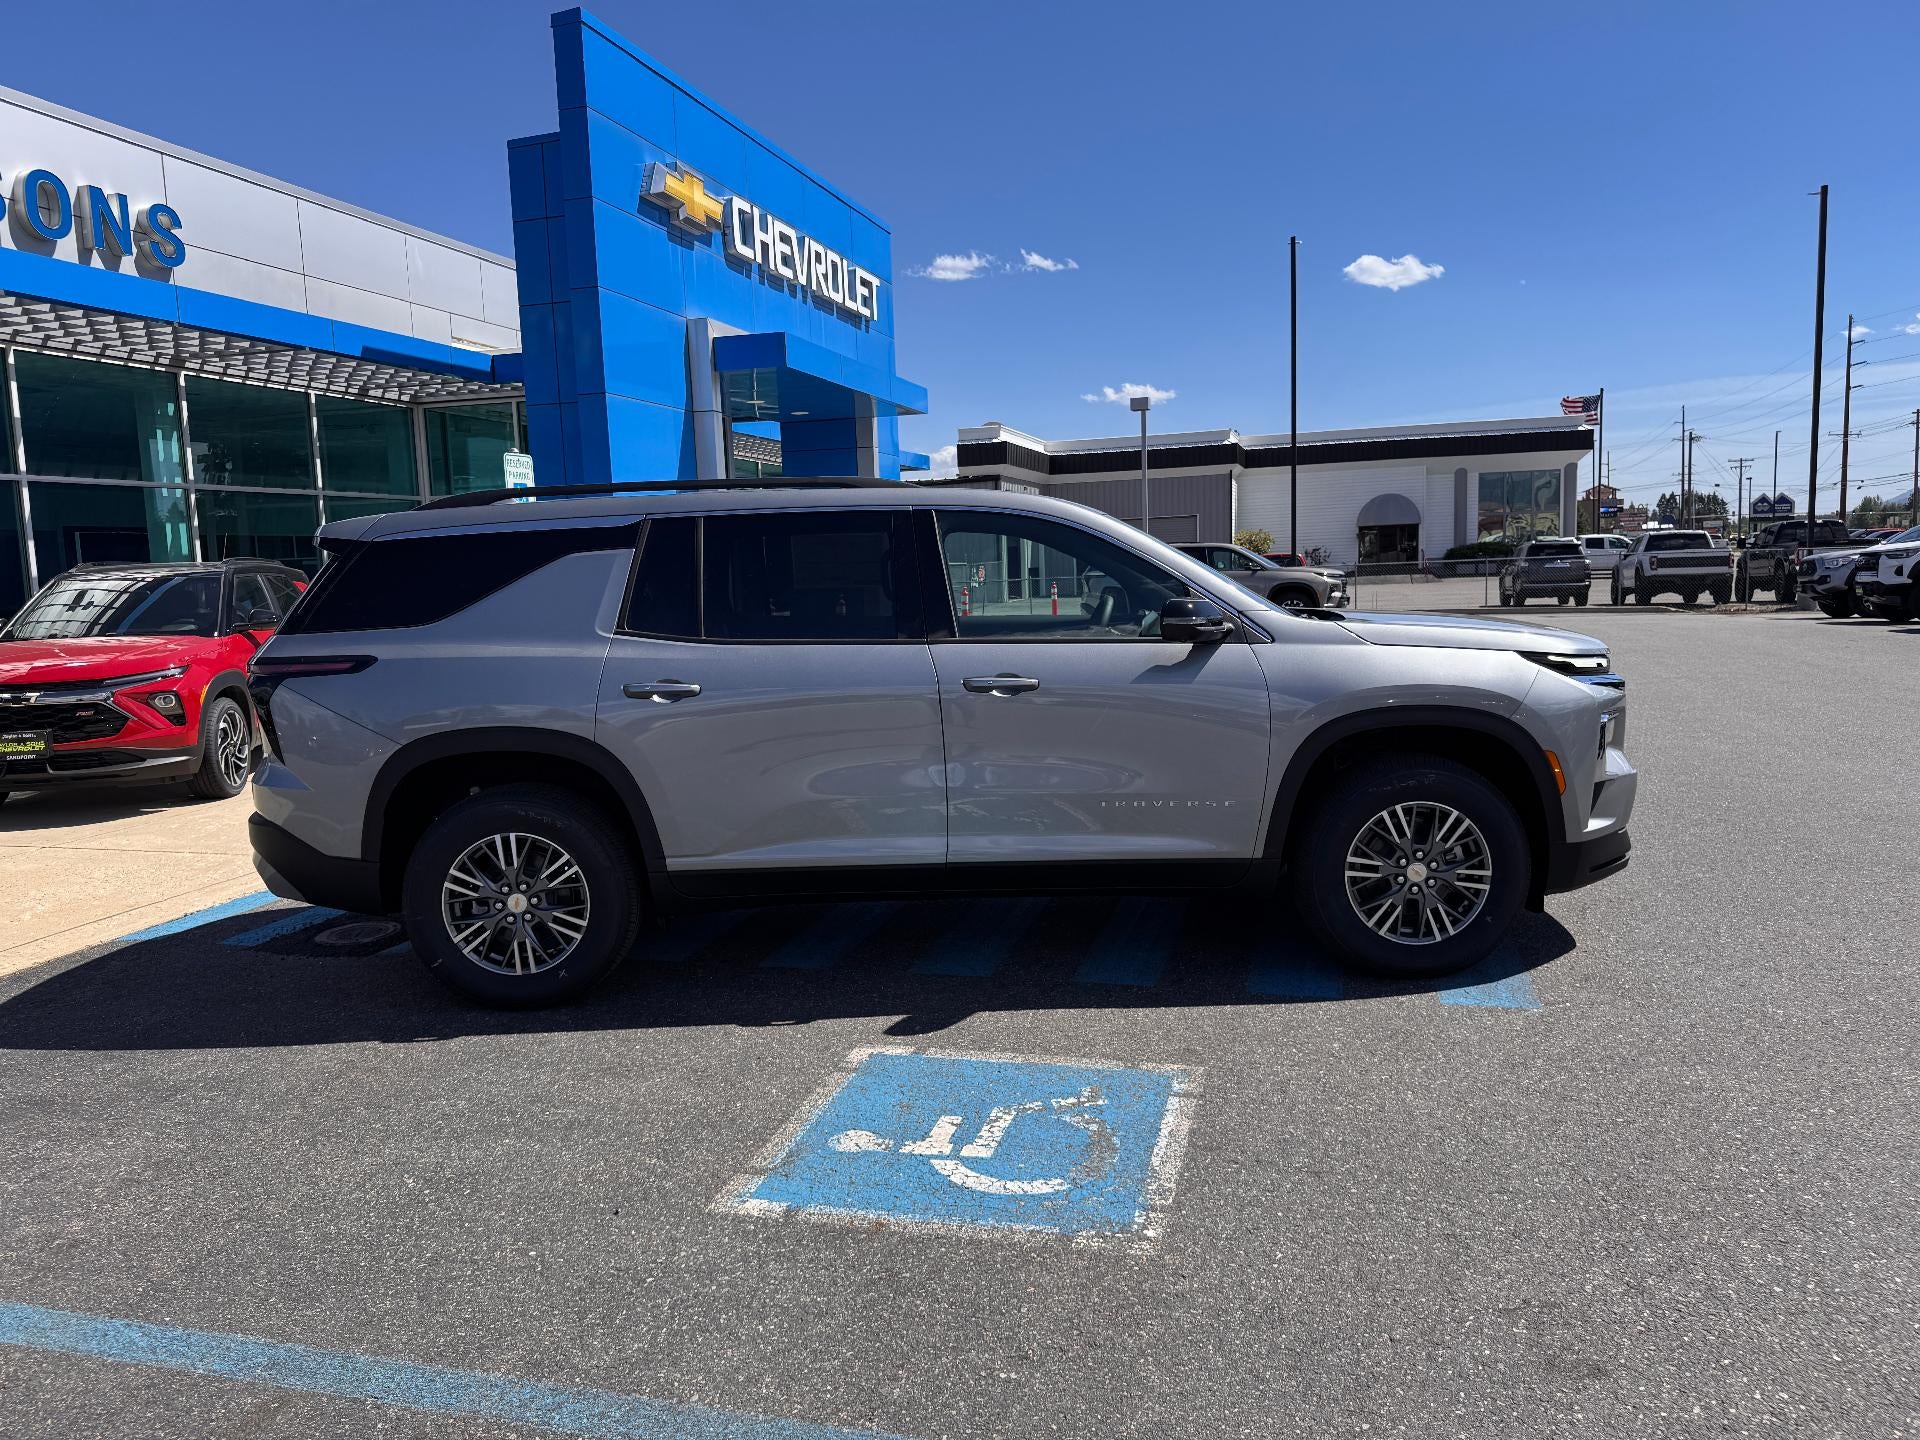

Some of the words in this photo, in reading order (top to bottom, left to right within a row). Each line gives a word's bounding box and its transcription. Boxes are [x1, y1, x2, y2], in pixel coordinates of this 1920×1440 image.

[0, 166, 186, 268] ONS
[730, 196, 881, 321] CHEVROLET
[1100, 800, 1237, 808] TRAVERSE
